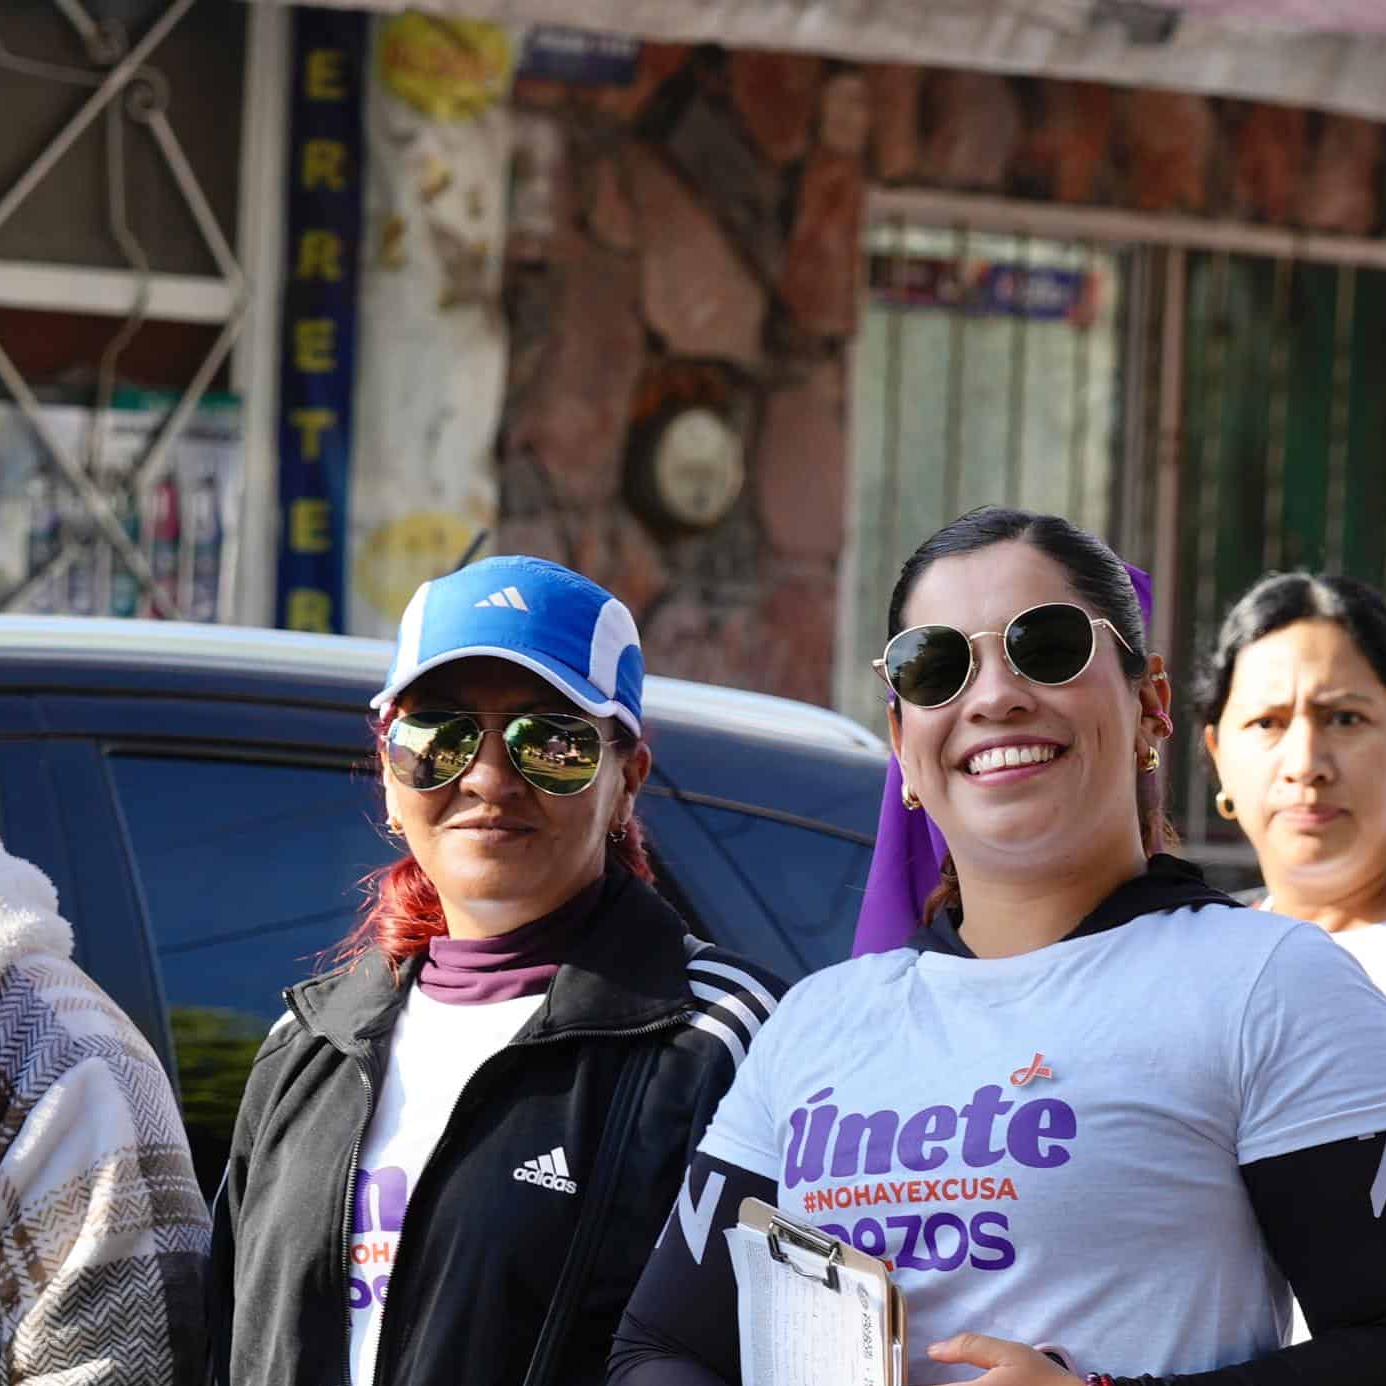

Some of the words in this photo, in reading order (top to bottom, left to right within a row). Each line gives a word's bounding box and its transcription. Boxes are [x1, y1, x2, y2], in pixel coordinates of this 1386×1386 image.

[784, 1084, 1077, 1190] únete
[513, 1167, 578, 1195] adidas
[803, 1176, 1019, 1214] #NOHAYEXCUSA
